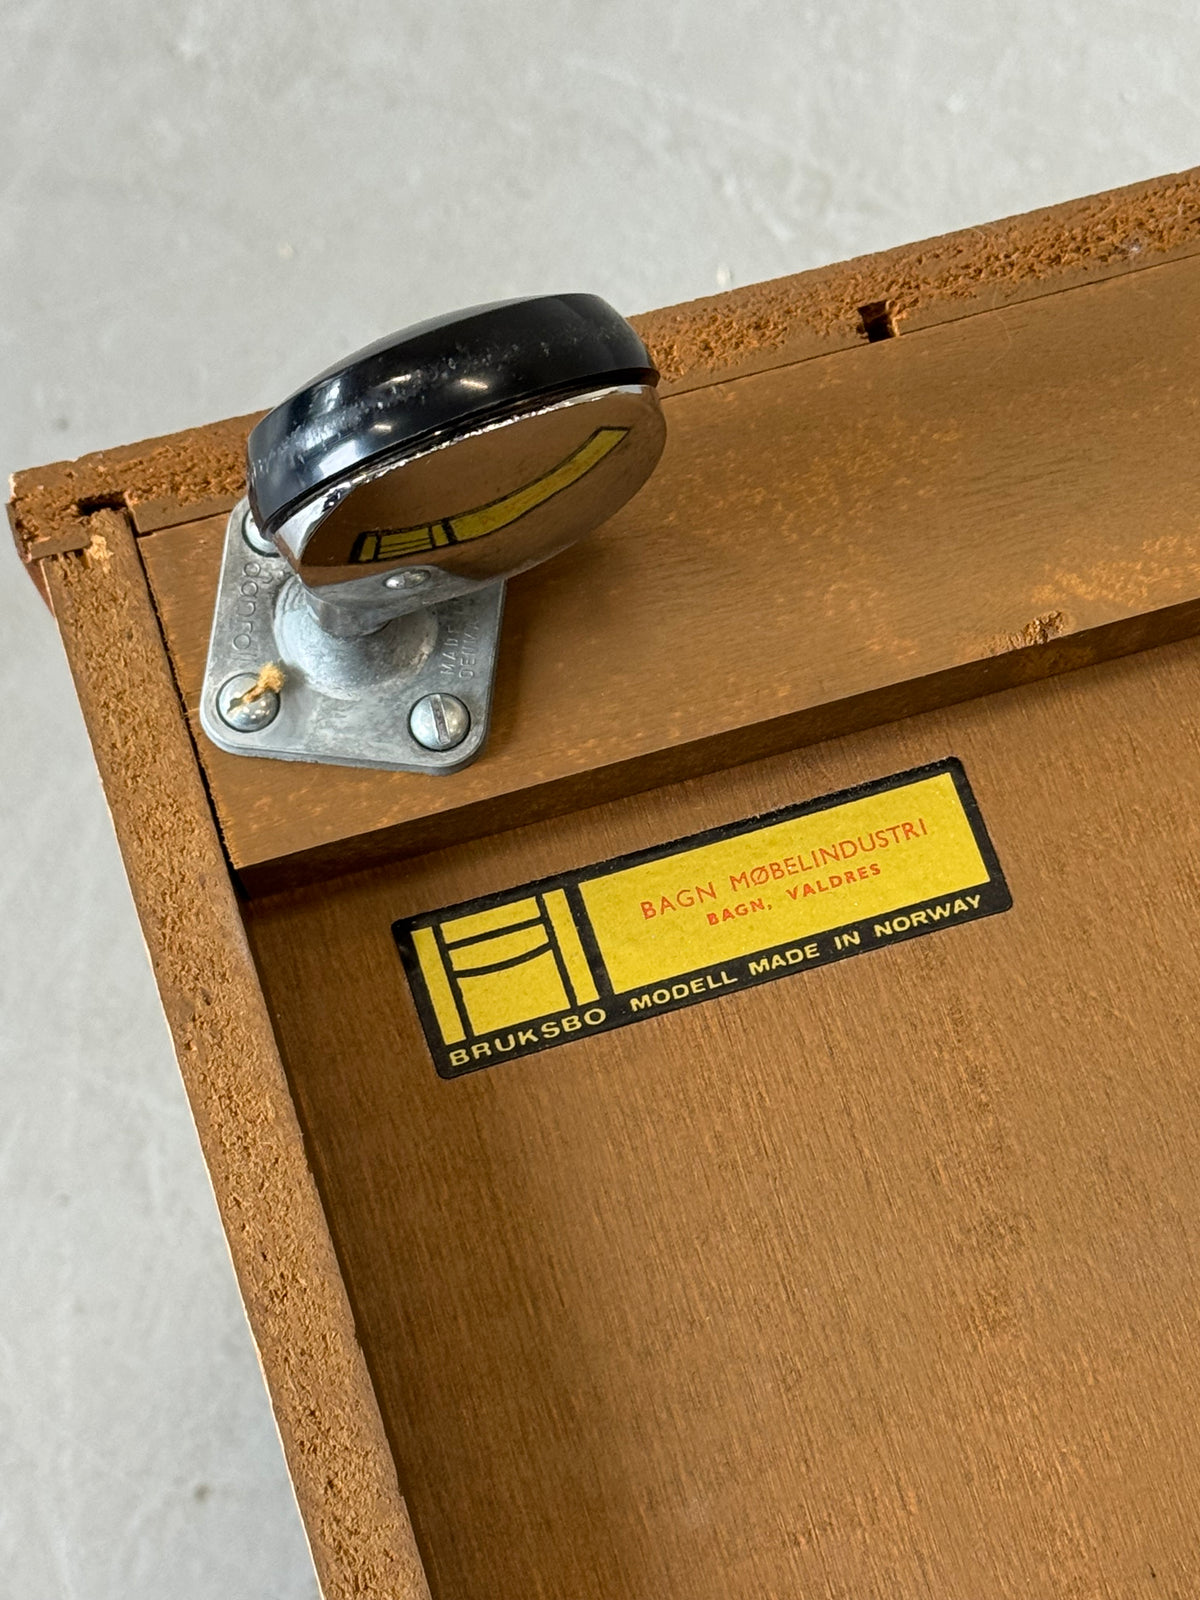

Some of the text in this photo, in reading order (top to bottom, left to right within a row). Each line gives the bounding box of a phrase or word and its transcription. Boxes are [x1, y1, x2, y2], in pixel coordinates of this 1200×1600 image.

[459, 604, 482, 679] DENMA
[640, 817, 928, 920] BAGN MØBELINDUSTRI
[706, 863, 882, 926] BAGN, VALDRES
[449, 894, 982, 1067] BRUKSBO MODELL MADE IN NORWAY
